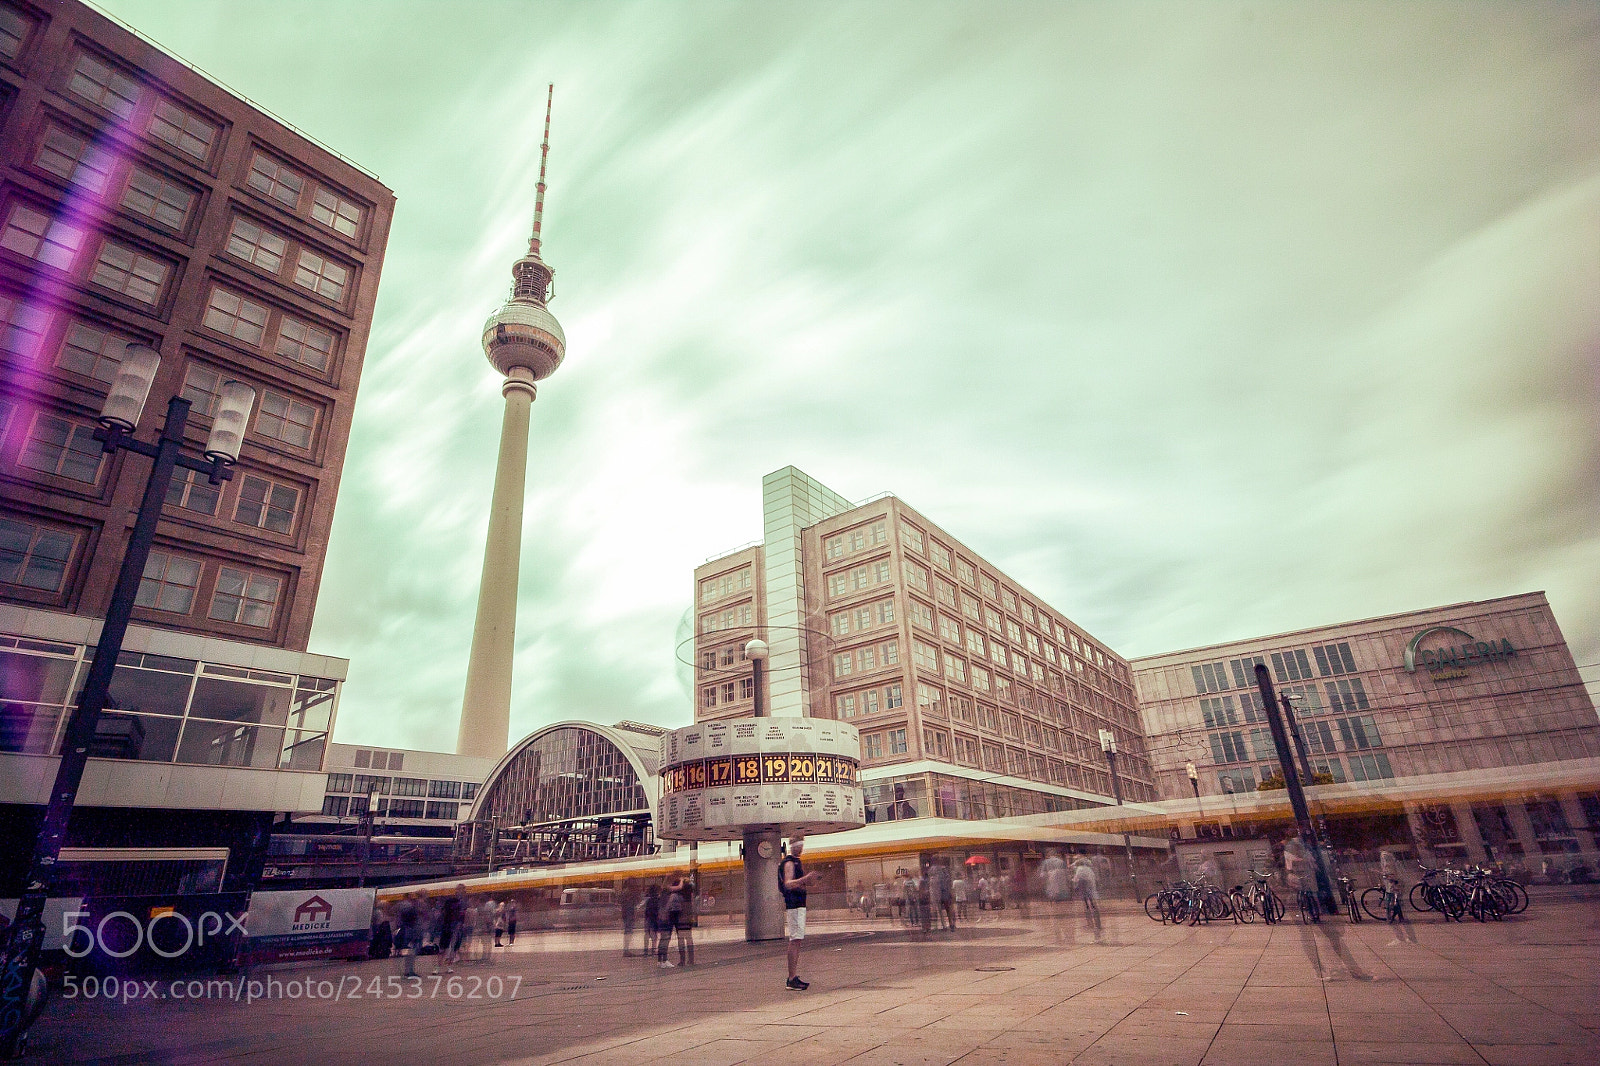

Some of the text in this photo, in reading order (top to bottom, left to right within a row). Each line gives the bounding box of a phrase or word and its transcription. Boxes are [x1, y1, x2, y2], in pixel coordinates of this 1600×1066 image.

[1421, 637, 1519, 671] GALERIA
[674, 769, 685, 788] 15
[689, 765, 704, 784] 16
[711, 762, 731, 780] 17
[737, 760, 759, 779] 18
[764, 759, 786, 777] 19
[791, 759, 813, 777] 20
[817, 760, 832, 777] 21
[835, 761, 849, 779] 22
[895, 865, 908, 875] dm
[292, 922, 331, 931] MEDICKE
[278, 947, 333, 958] www.medicke.de
